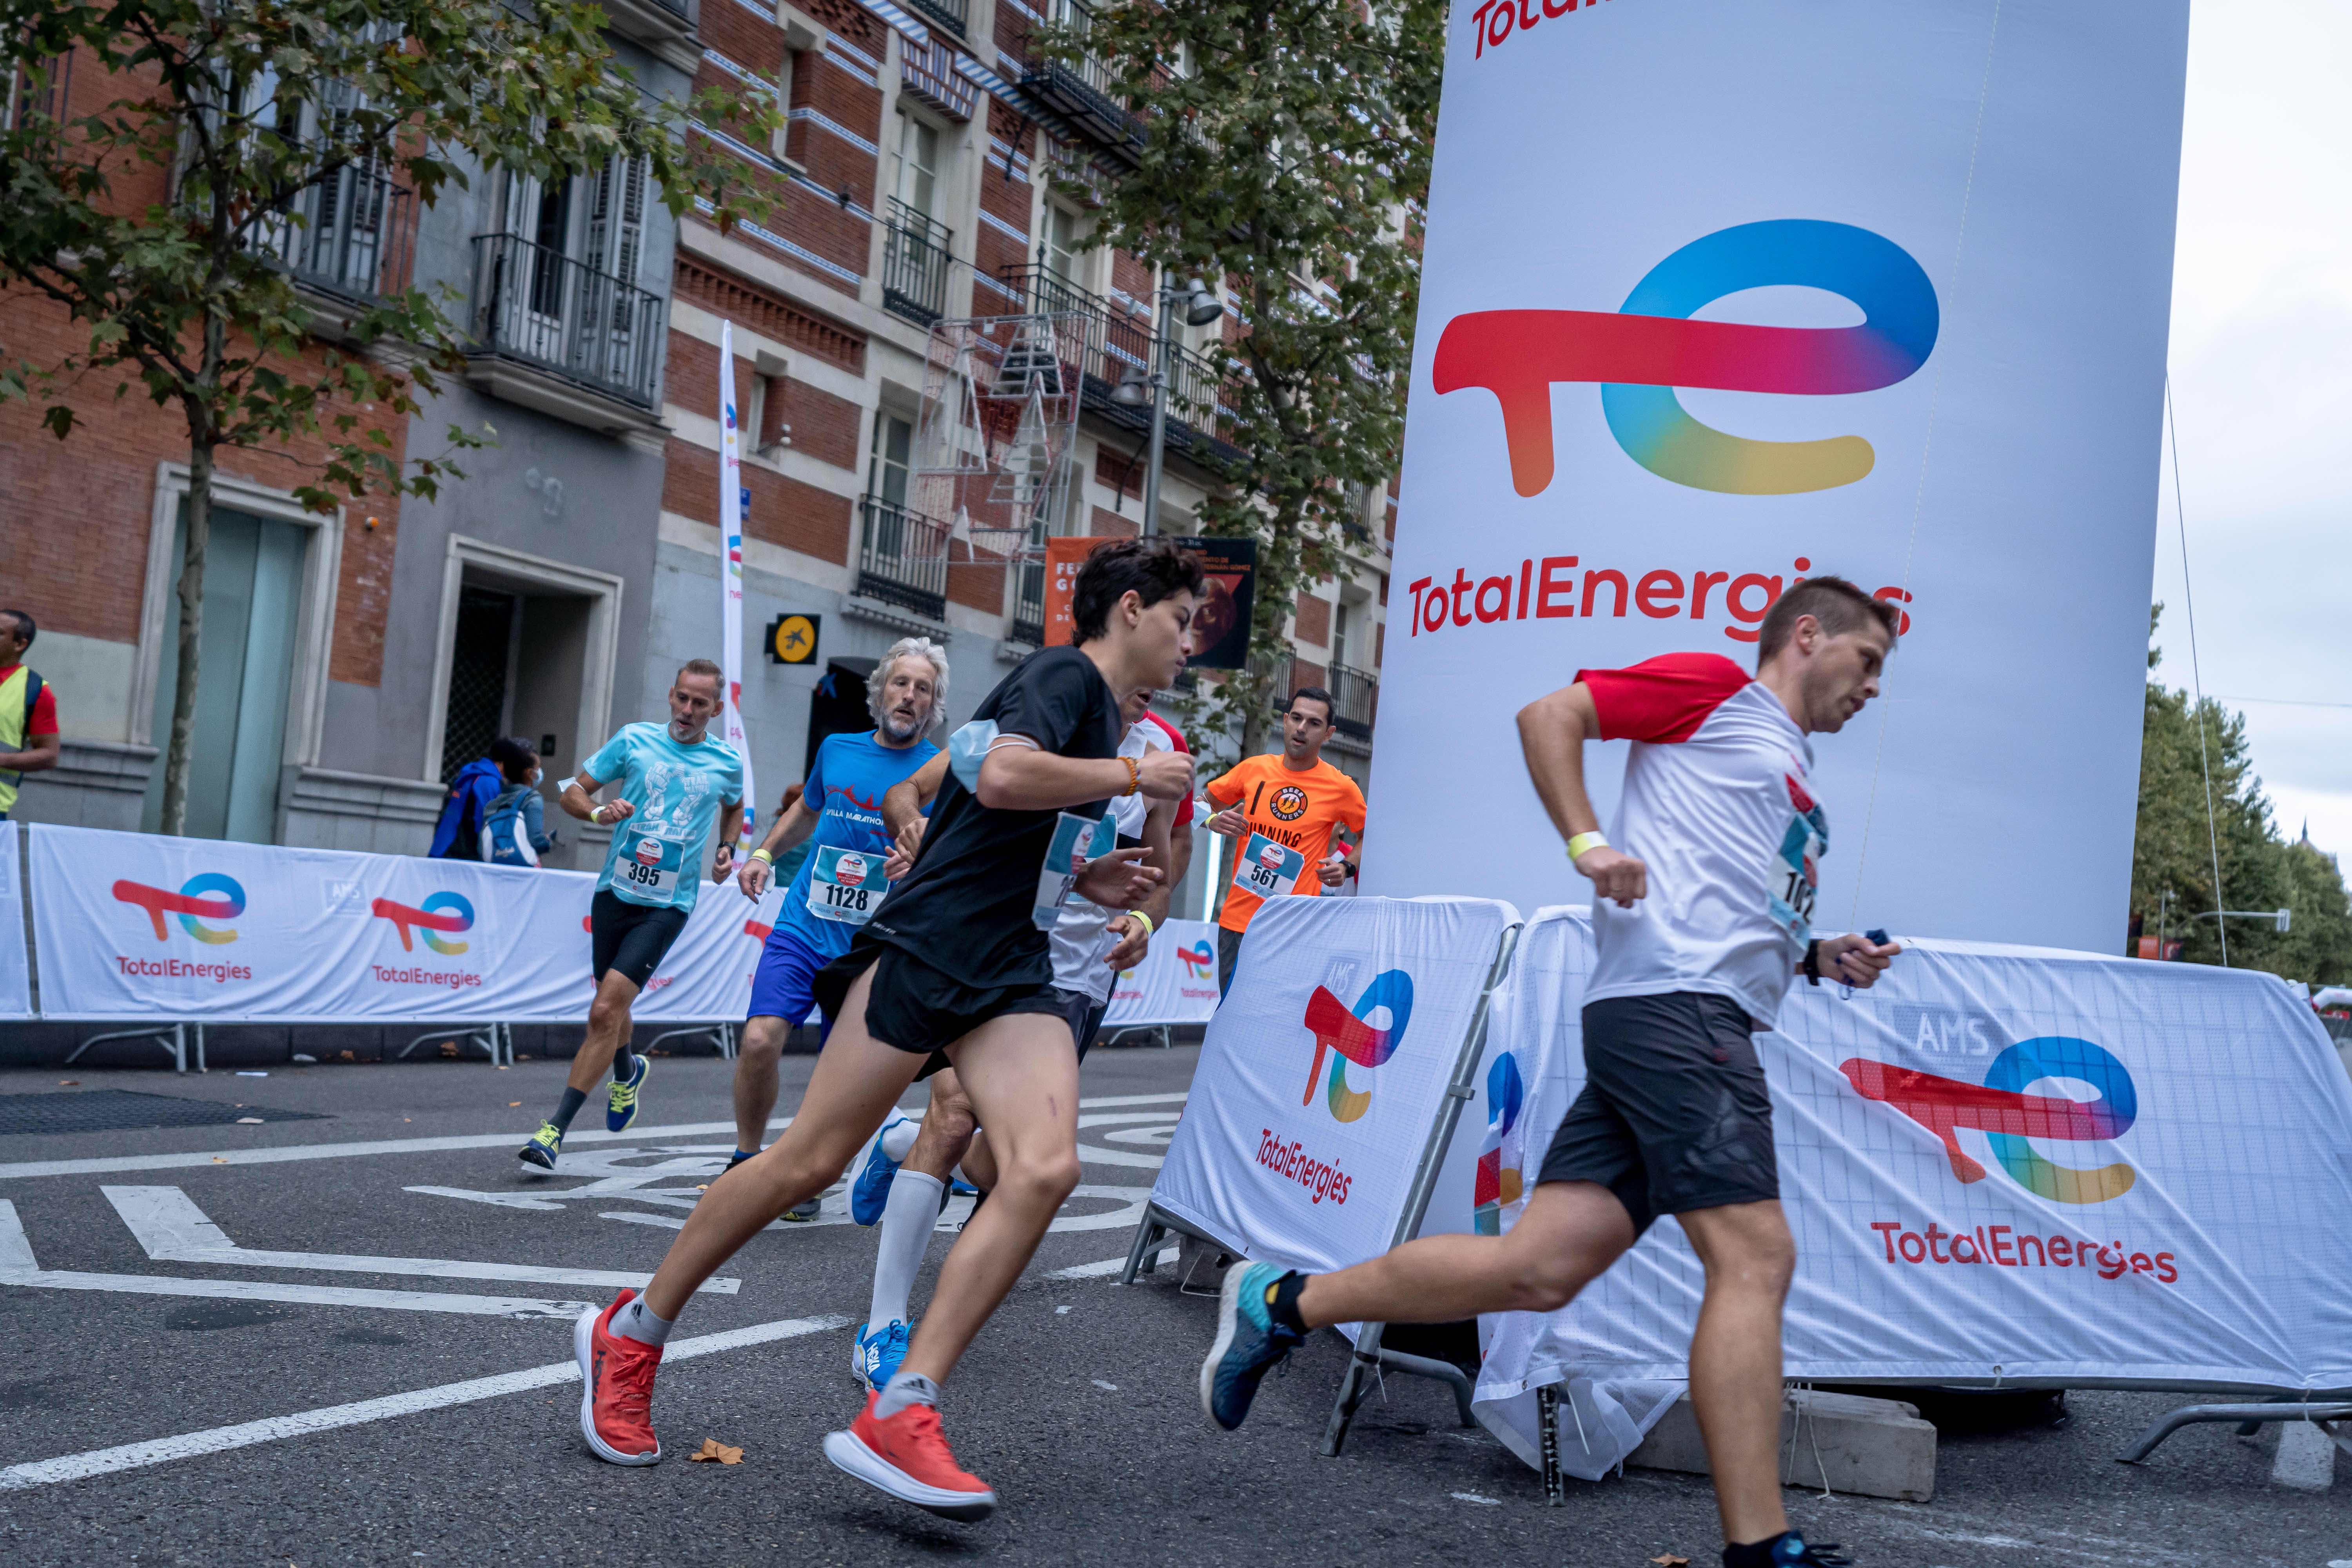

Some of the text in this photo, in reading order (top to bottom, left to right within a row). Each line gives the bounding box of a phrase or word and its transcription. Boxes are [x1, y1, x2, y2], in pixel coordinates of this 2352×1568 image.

[1409, 555, 1912, 642] TotalEnergs
[1282, 787, 1304, 798] BEER
[1271, 802, 1303, 820] RUNNERS
[1245, 822, 1301, 848] UNNING
[628, 862, 661, 886] 395
[1251, 864, 1279, 889] 561
[826, 884, 868, 911] 1128
[116, 956, 252, 983] TotalEnergies
[372, 965, 482, 990] TotalEnergies
[1916, 1013, 1989, 1055] AMS
[1256, 1128, 1352, 1205] TotalEnergies
[867, 1342, 880, 1376] HOKA
